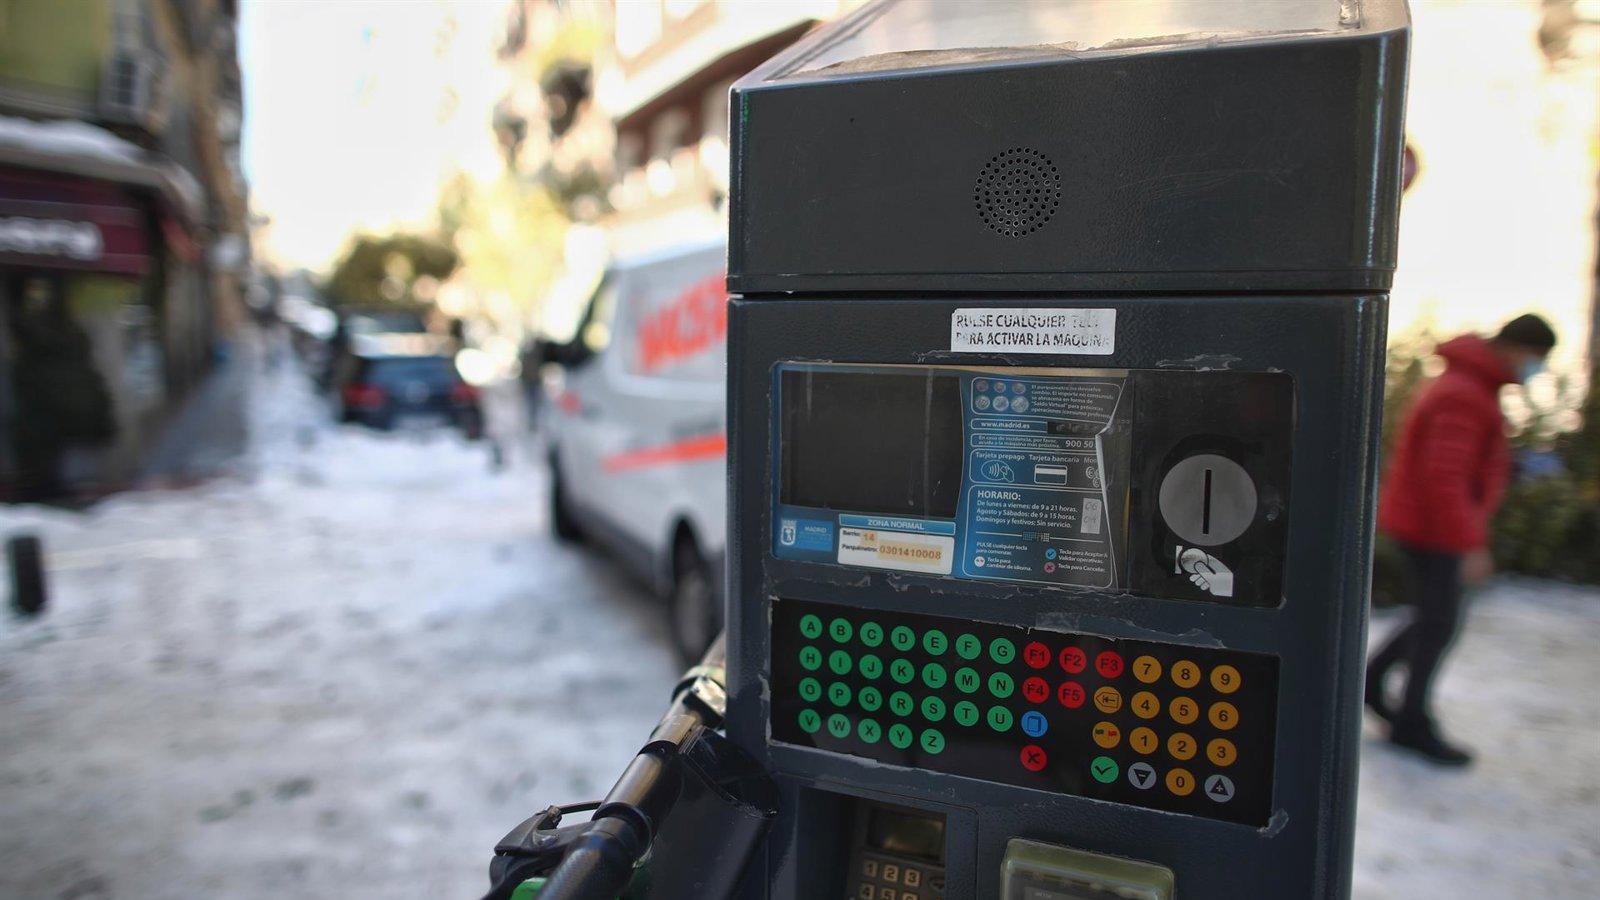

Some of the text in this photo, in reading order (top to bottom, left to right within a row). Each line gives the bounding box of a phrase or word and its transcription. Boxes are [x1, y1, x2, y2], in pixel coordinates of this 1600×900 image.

[996, 315, 1066, 329] CUALQUIER
[987, 333, 1033, 345] ACTIVAR
[1036, 333, 1049, 345] LA
[1084, 440, 1094, 448] 50
[999, 453, 1025, 461] prepago
[1029, 454, 1051, 463] Tarjeta
[1052, 455, 1079, 463] bancaria
[977, 491, 1021, 500] HORARIO:
[976, 508, 997, 516] Agosto
[867, 519, 925, 530] ZONA NORMAL
[976, 516, 1006, 524] Domingos
[1012, 518, 1036, 526] festivos:
[863, 532, 875, 541] 14
[879, 547, 941, 560] 0301410008
[807, 622, 1231, 685] A B C D E F G F1 F2 F3 7 8 9
[806, 653, 1228, 721] H I J K L M N F4 F5 4 5 6
[805, 685, 1226, 758] O P Q R S T U 1 2 3
[805, 716, 1185, 787] V W X Y Z 0
[887, 868, 895, 878] 2
[909, 872, 916, 883] 3
